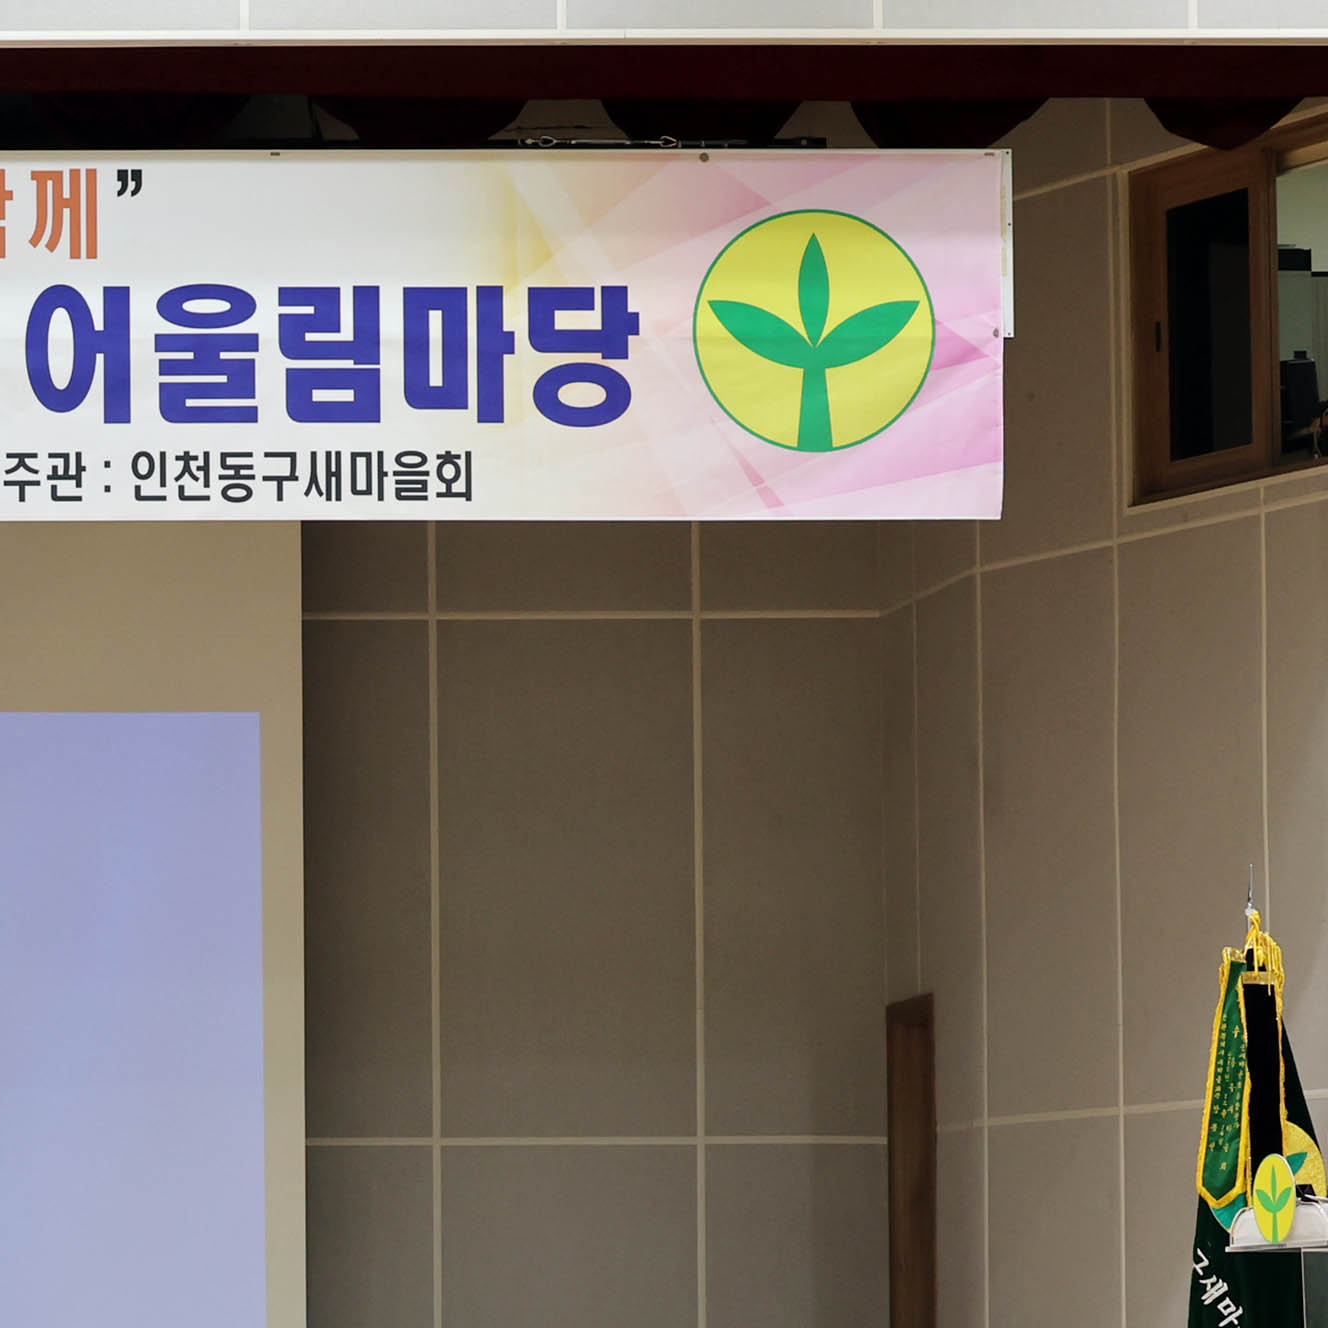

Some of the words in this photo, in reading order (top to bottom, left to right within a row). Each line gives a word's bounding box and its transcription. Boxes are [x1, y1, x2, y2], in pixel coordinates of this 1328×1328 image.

[25, 283, 640, 428] 어울림마당
[3, 450, 87, 502] 주관
[131, 450, 474, 503] 인천동구새마을회
